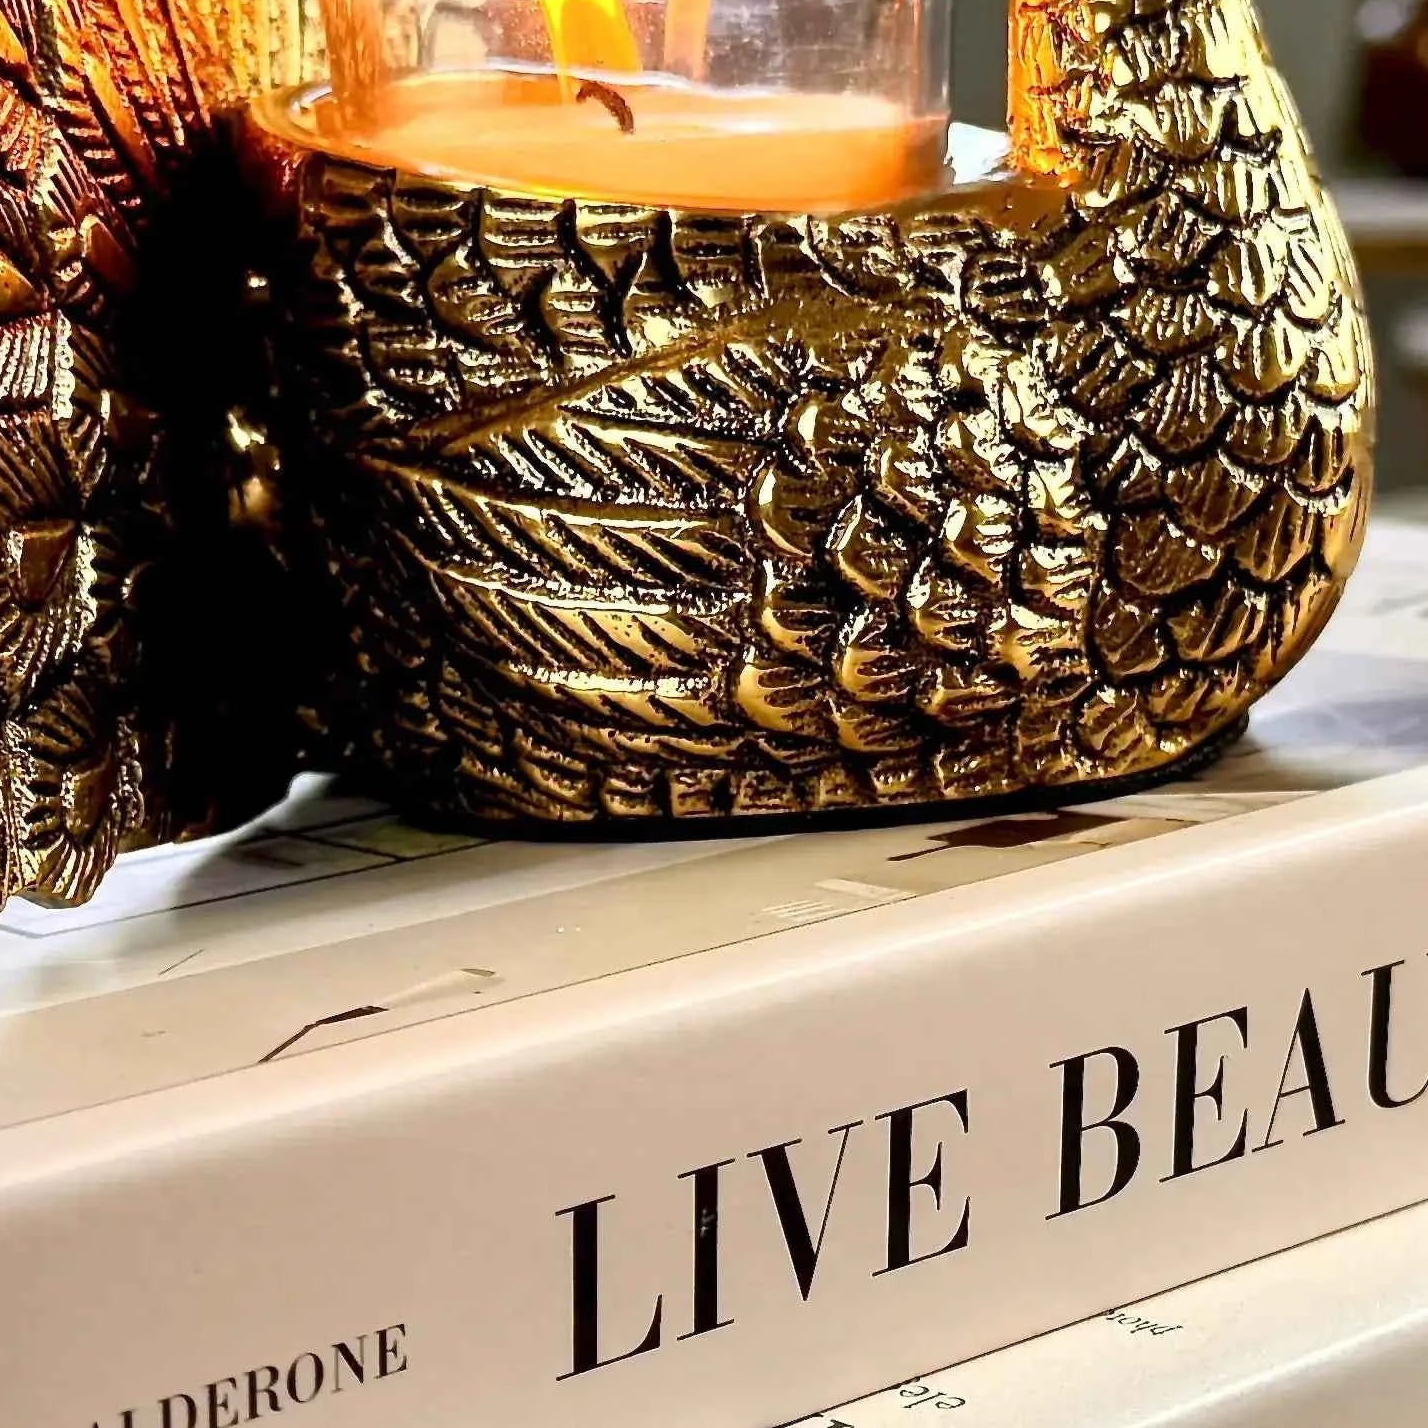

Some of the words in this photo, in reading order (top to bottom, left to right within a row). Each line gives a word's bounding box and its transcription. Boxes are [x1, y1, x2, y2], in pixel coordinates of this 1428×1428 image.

[553, 1086, 972, 1384] LIVE
[1097, 1308, 1185, 1337] phot
[894, 1375, 967, 1411] ele
